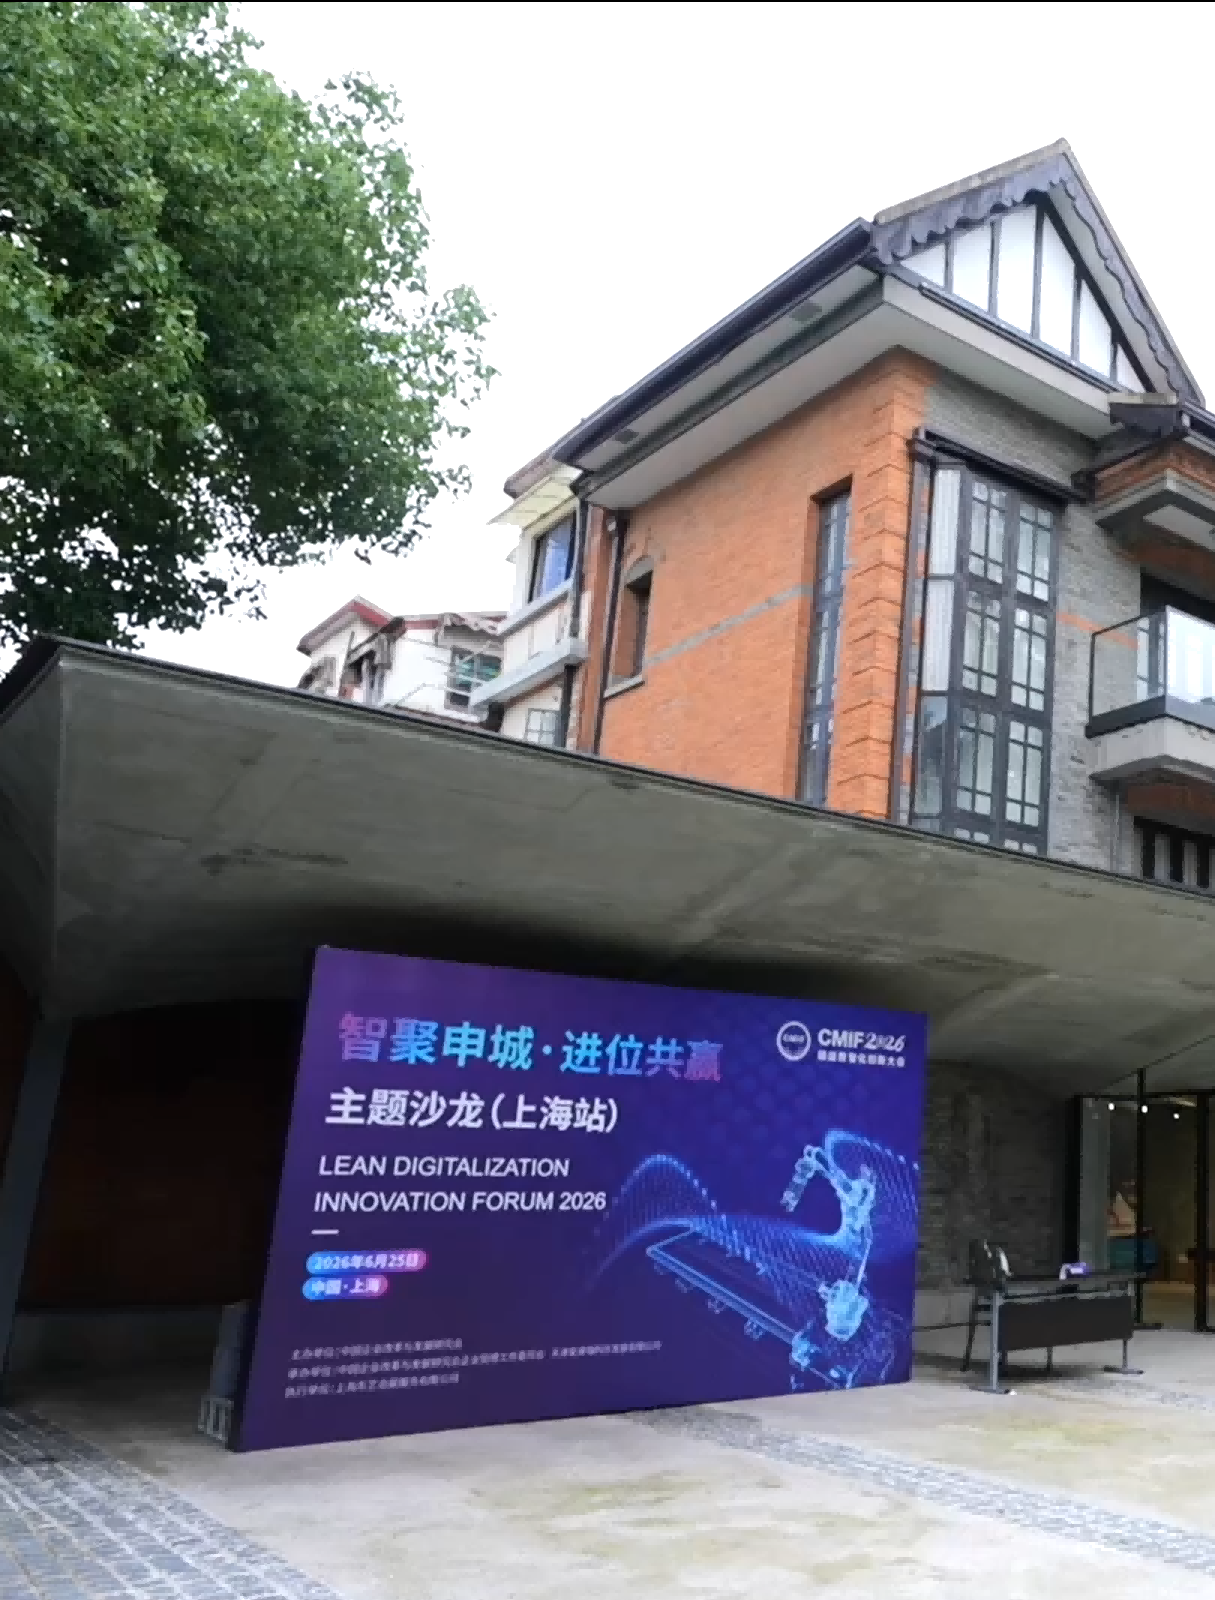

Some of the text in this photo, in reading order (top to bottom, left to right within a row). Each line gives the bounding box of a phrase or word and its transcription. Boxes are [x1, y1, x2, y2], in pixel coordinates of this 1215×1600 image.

[338, 1011, 724, 1082] 智聚申城·进位共赢
[324, 1086, 619, 1133] 主题沙龙(上海站)
[318, 1155, 570, 1178] LEAN DIGITALIZATION
[313, 1191, 607, 1213] INNOVATION FORUM 2026
